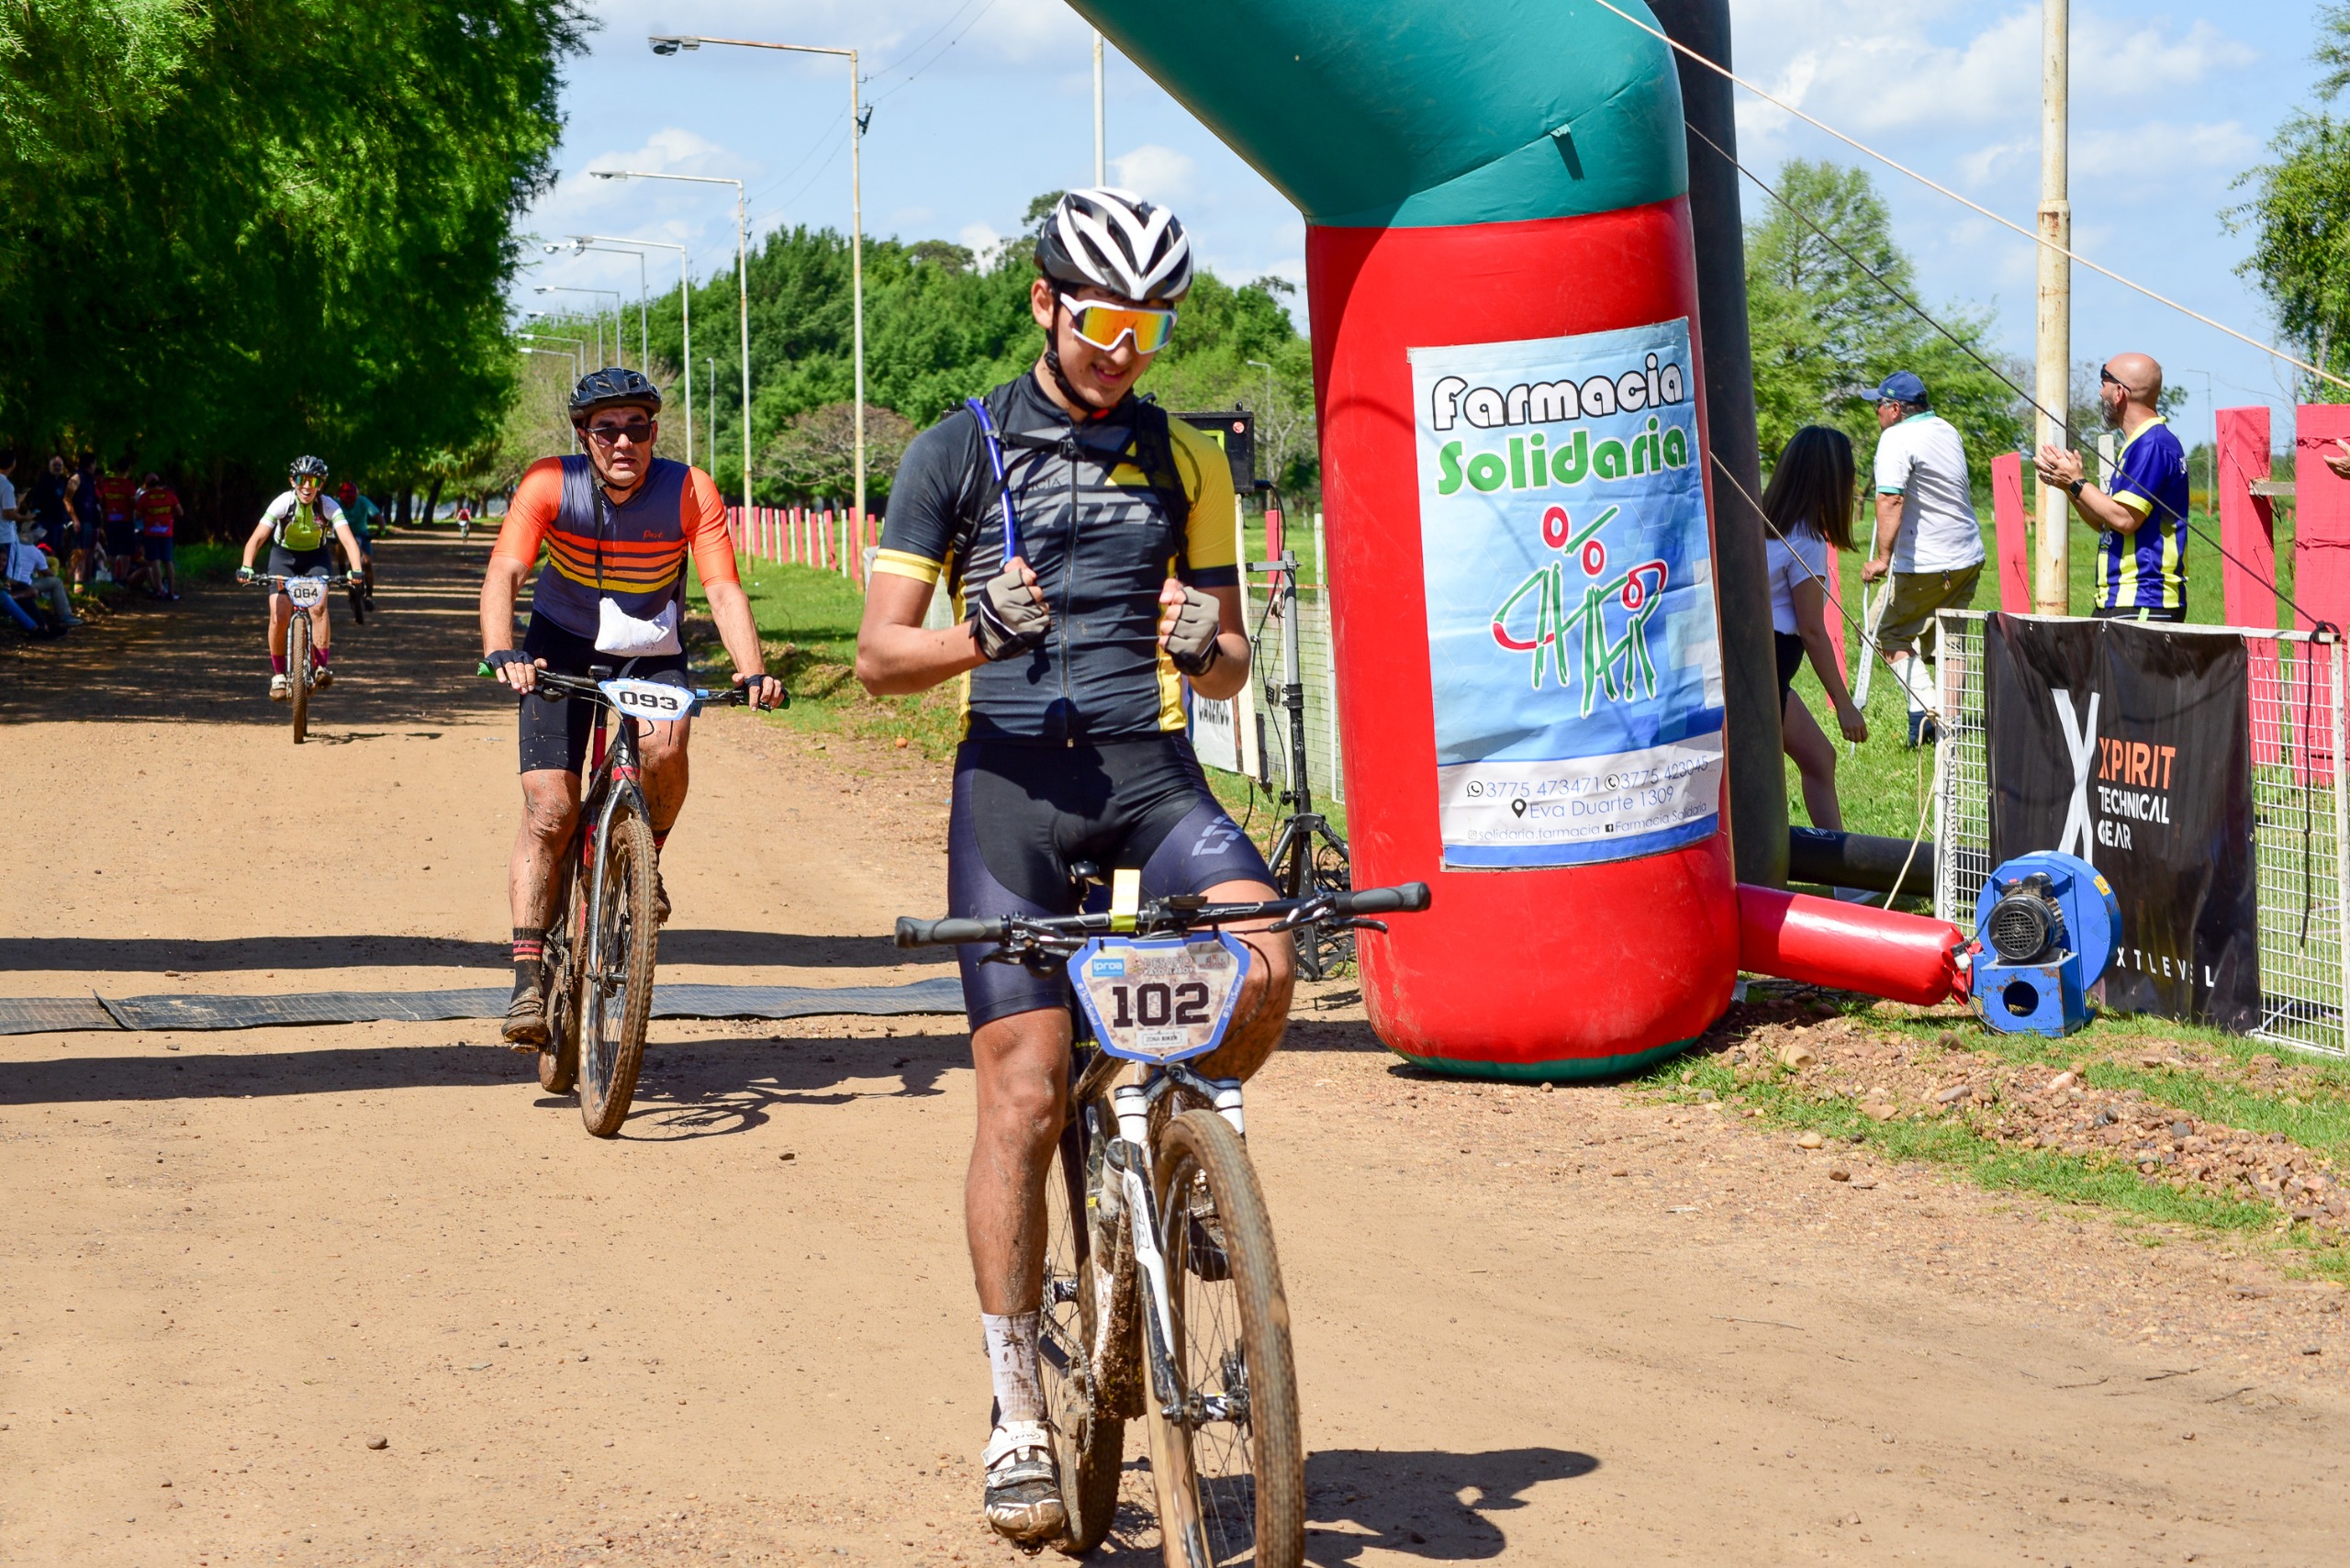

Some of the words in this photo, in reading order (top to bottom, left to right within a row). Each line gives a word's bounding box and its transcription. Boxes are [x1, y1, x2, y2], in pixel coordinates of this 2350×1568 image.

[1431, 352, 1684, 431] Farmacia
[1438, 418, 1688, 496] Solidaria
[619, 690, 678, 711] 093
[1485, 781, 1530, 798] 3775
[1537, 777, 1600, 798] 473471
[1620, 767, 1660, 790] 3775
[1664, 756, 1709, 780] 423045
[2098, 736, 2177, 790] XPIRIT
[1529, 802, 1564, 819] Eva
[1572, 795, 1634, 816] Duarte
[1640, 785, 1674, 807] 1309
[1615, 811, 1670, 833] Farmacia
[1672, 801, 1707, 823] Solidaria
[2098, 785, 2170, 824] TECHNICAL
[2097, 819, 2132, 851] GEAR
[1112, 981, 1210, 1028] 102
